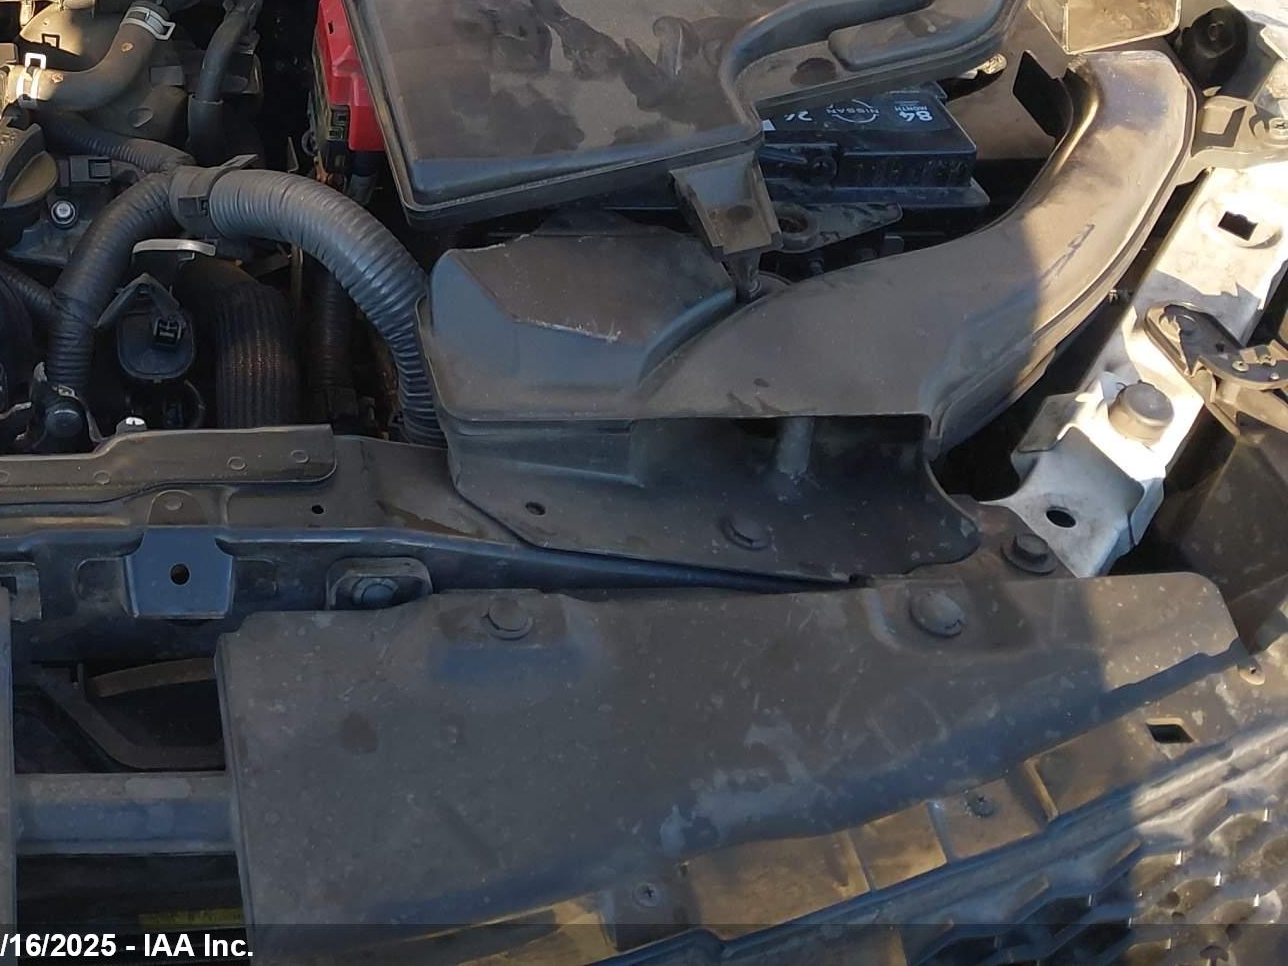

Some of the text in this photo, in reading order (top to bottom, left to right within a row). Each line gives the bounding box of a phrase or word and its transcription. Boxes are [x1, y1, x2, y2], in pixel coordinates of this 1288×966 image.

[826, 107, 880, 115] NISSAN
[894, 104, 928, 112] MONTH
[899, 110, 933, 122] 84
